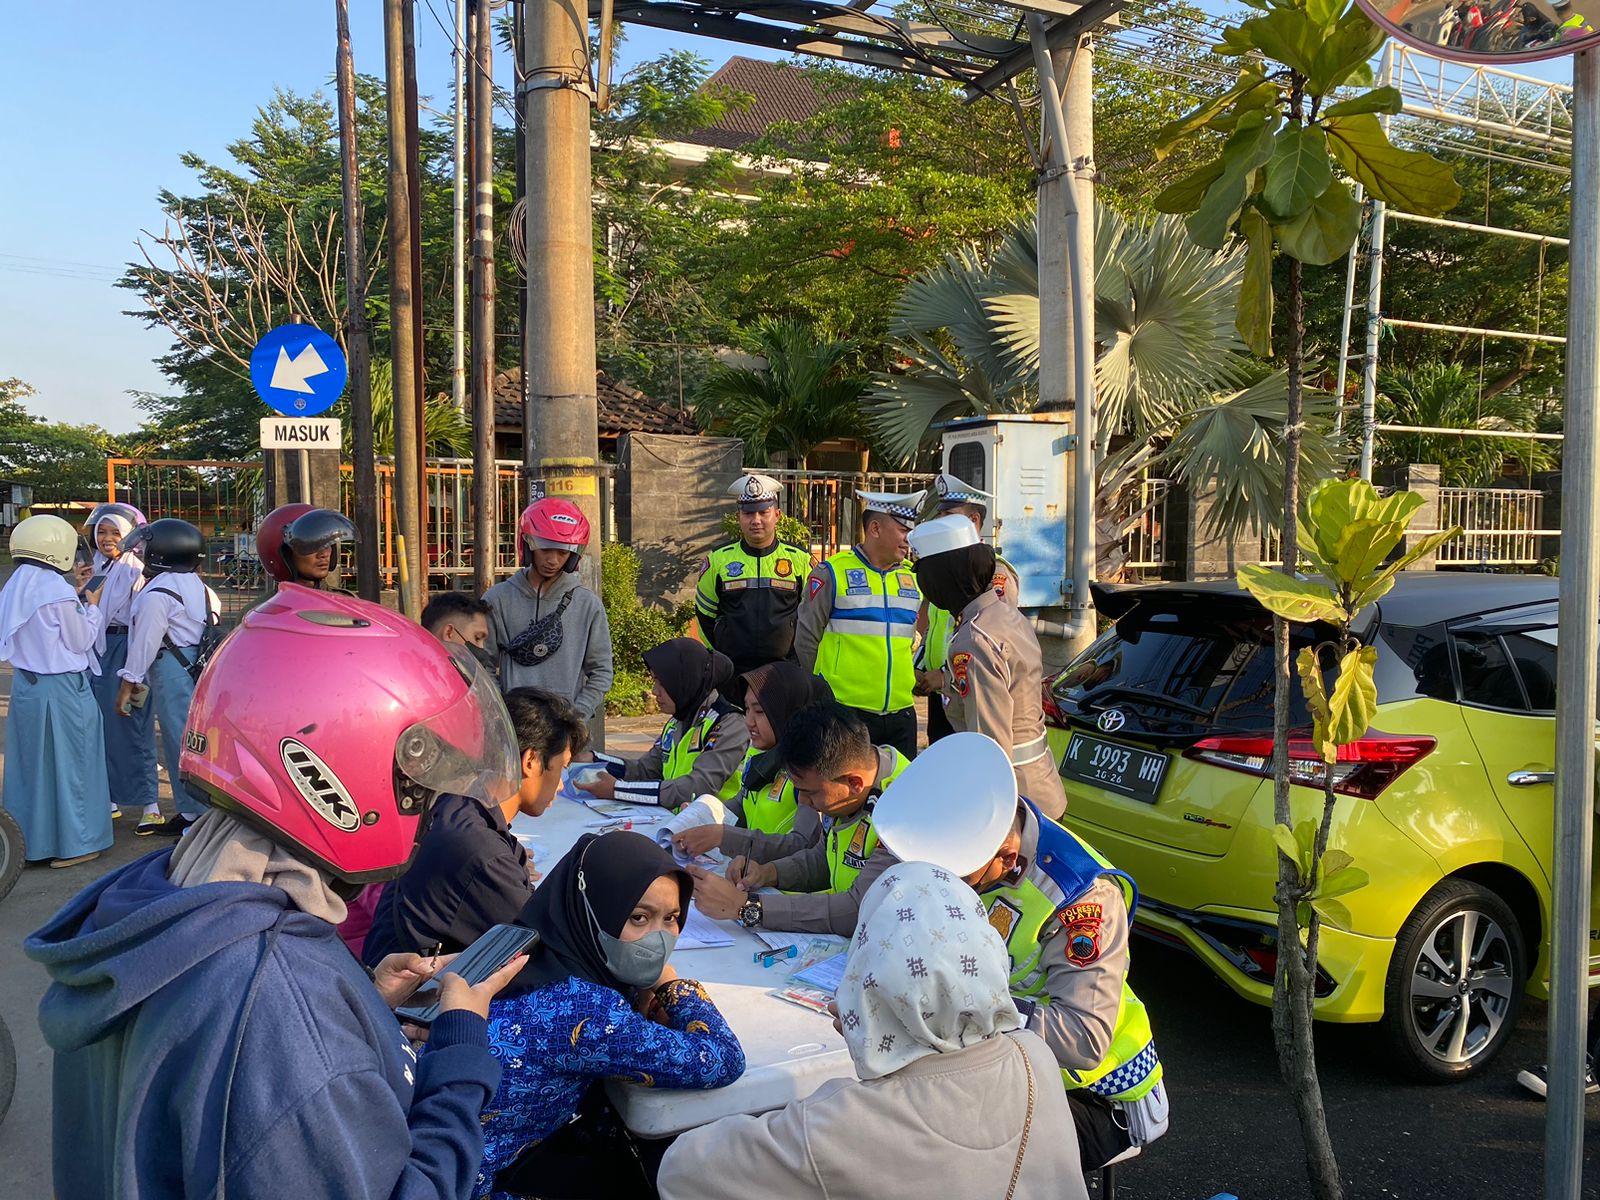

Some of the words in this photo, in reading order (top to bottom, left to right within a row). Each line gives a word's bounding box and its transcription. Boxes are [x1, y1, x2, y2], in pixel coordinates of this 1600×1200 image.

[275, 425, 330, 442] MASUK
[548, 480, 574, 492] 116
[187, 731, 205, 752] DOT
[1069, 738, 1083, 761] K
[1089, 744, 1131, 773] 1993
[1138, 756, 1162, 783] WH
[286, 750, 358, 822] INK
[1061, 905, 1101, 920] POLRESTA
[1068, 911, 1097, 922] PATI
